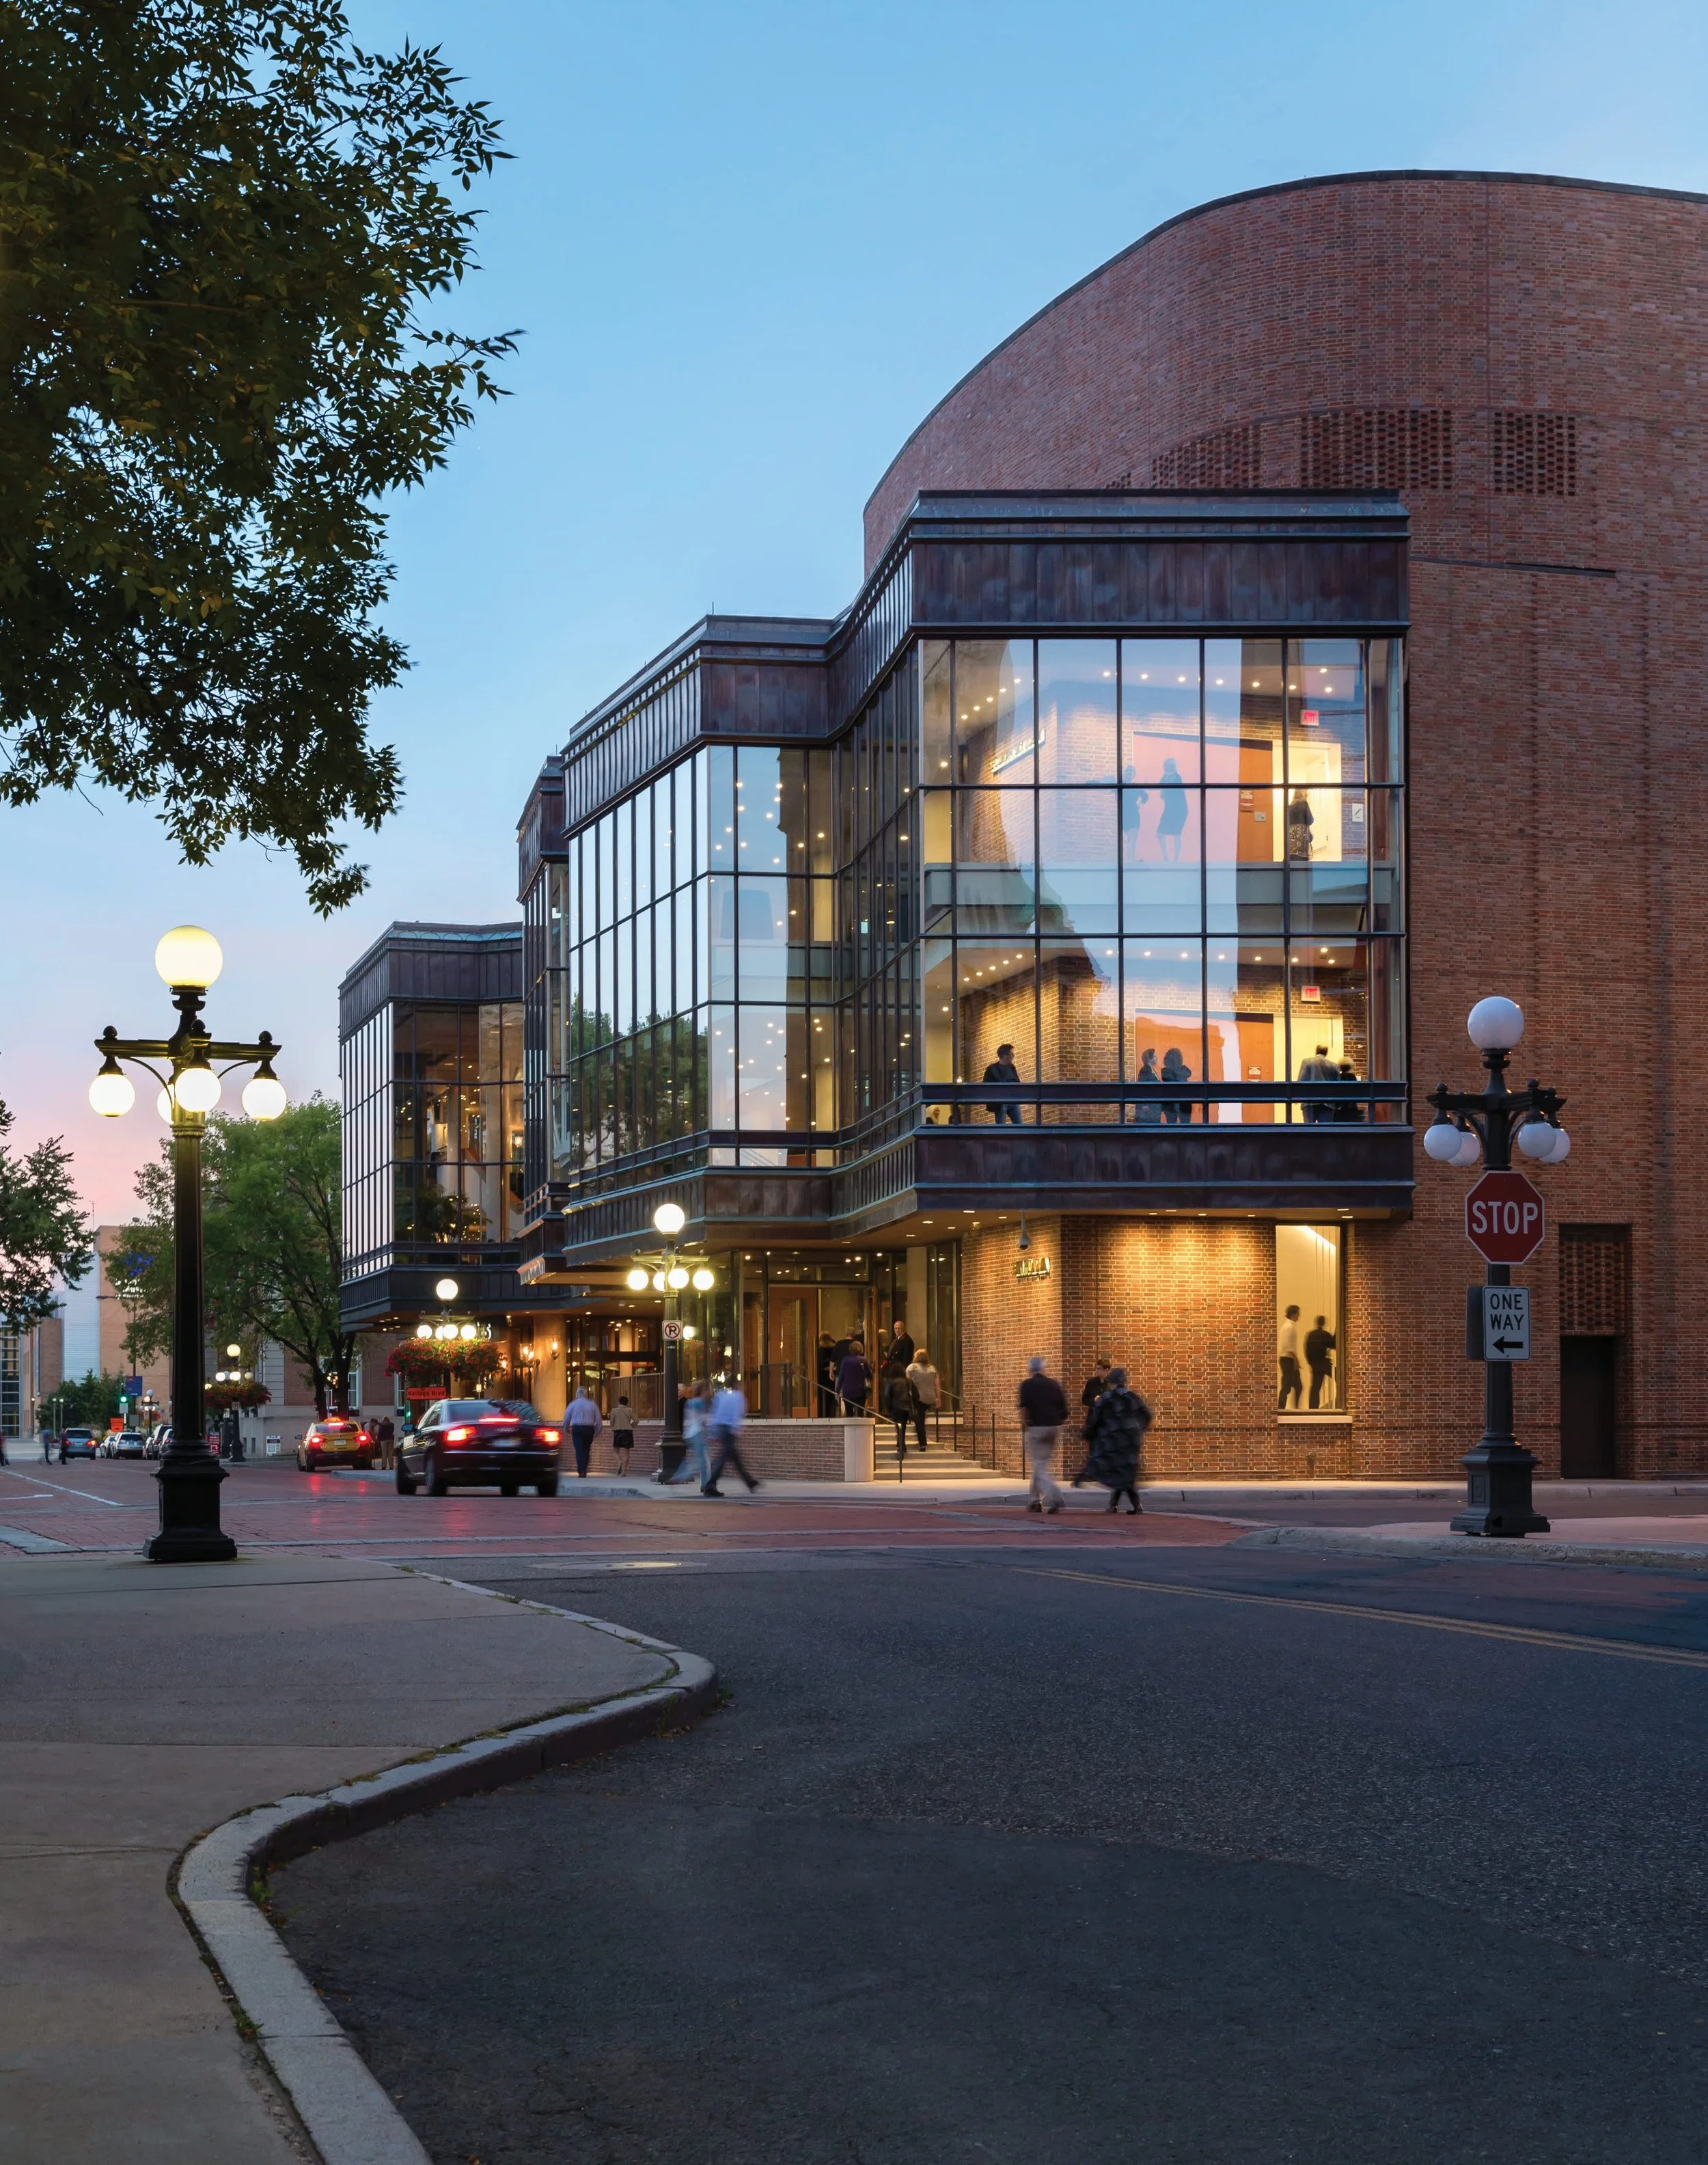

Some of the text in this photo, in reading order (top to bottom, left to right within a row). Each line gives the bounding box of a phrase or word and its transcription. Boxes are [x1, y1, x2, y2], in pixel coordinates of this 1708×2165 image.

[1472, 1201, 1539, 1234] STOP
[1490, 1294, 1523, 1310] ONE
[1490, 1313, 1524, 1331] WAY
